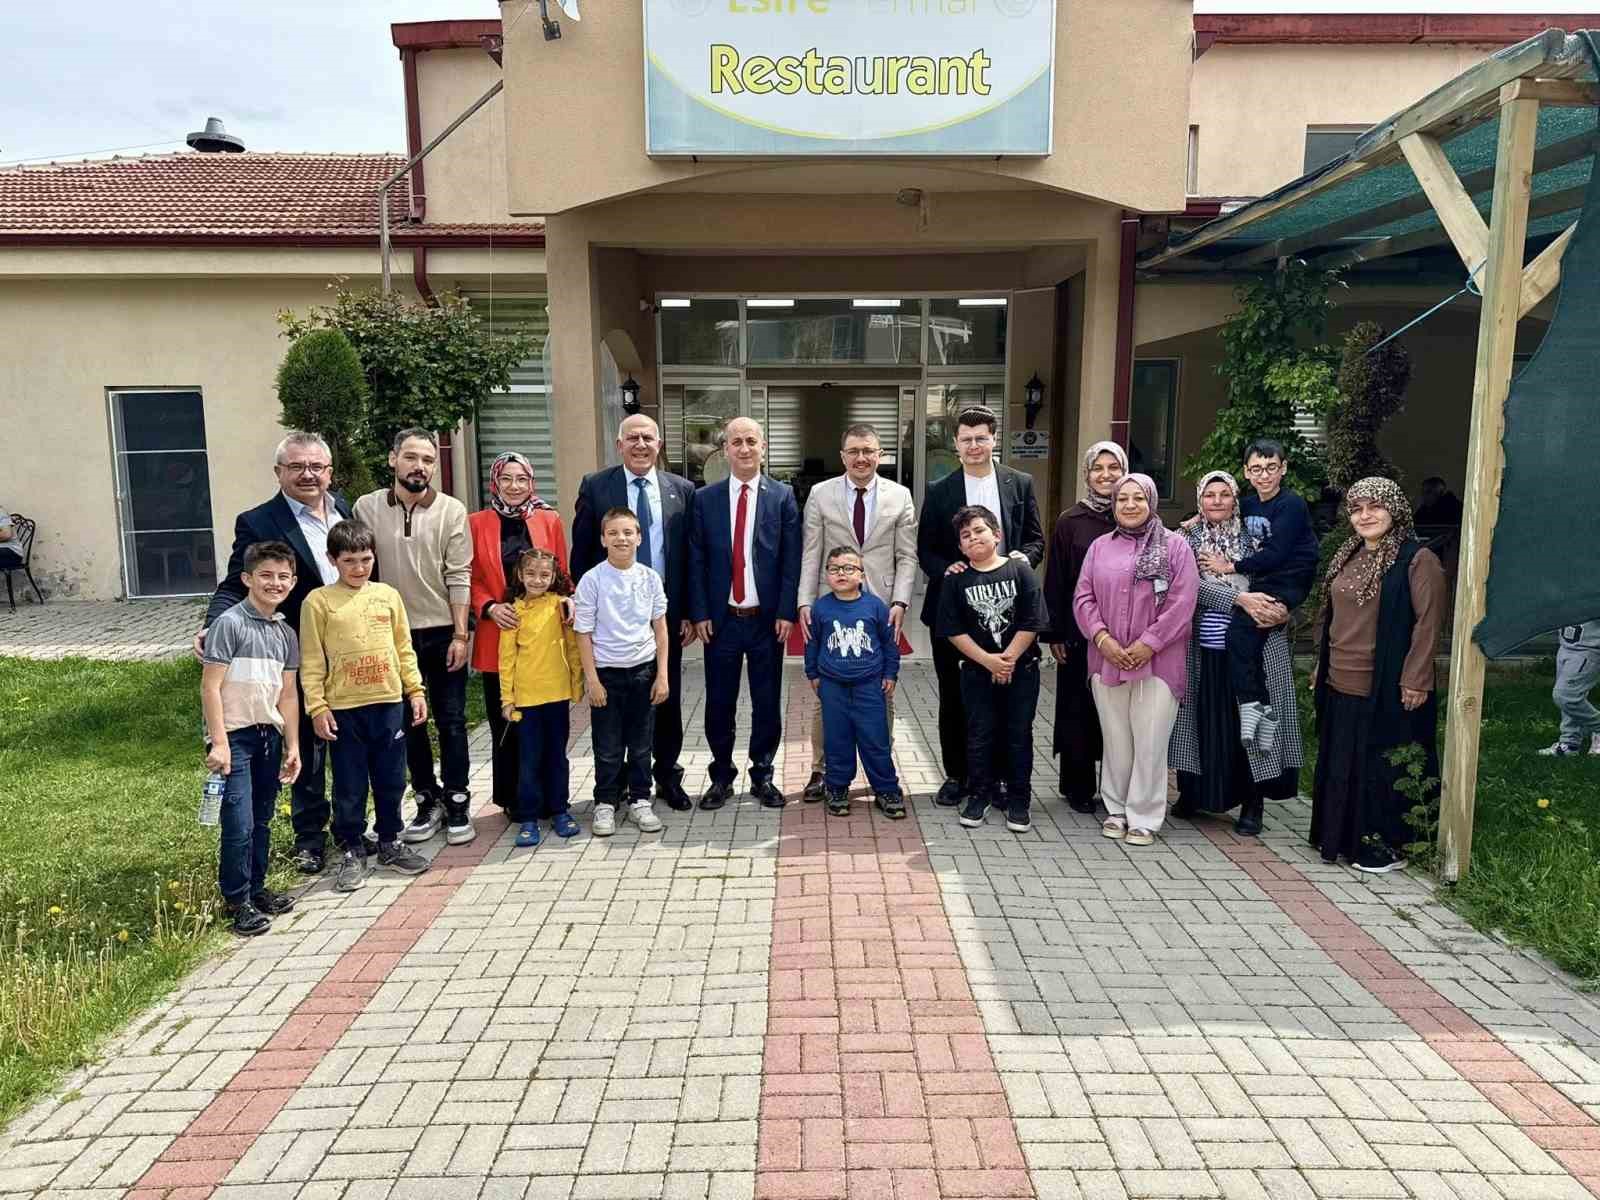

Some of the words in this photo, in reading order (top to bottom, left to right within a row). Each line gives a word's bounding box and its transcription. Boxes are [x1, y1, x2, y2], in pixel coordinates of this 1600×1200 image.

[710, 44, 991, 96] Restaurant
[965, 580, 1017, 600] NIRVANA
[359, 655, 378, 665] YOU
[349, 664, 390, 678] BETTER
